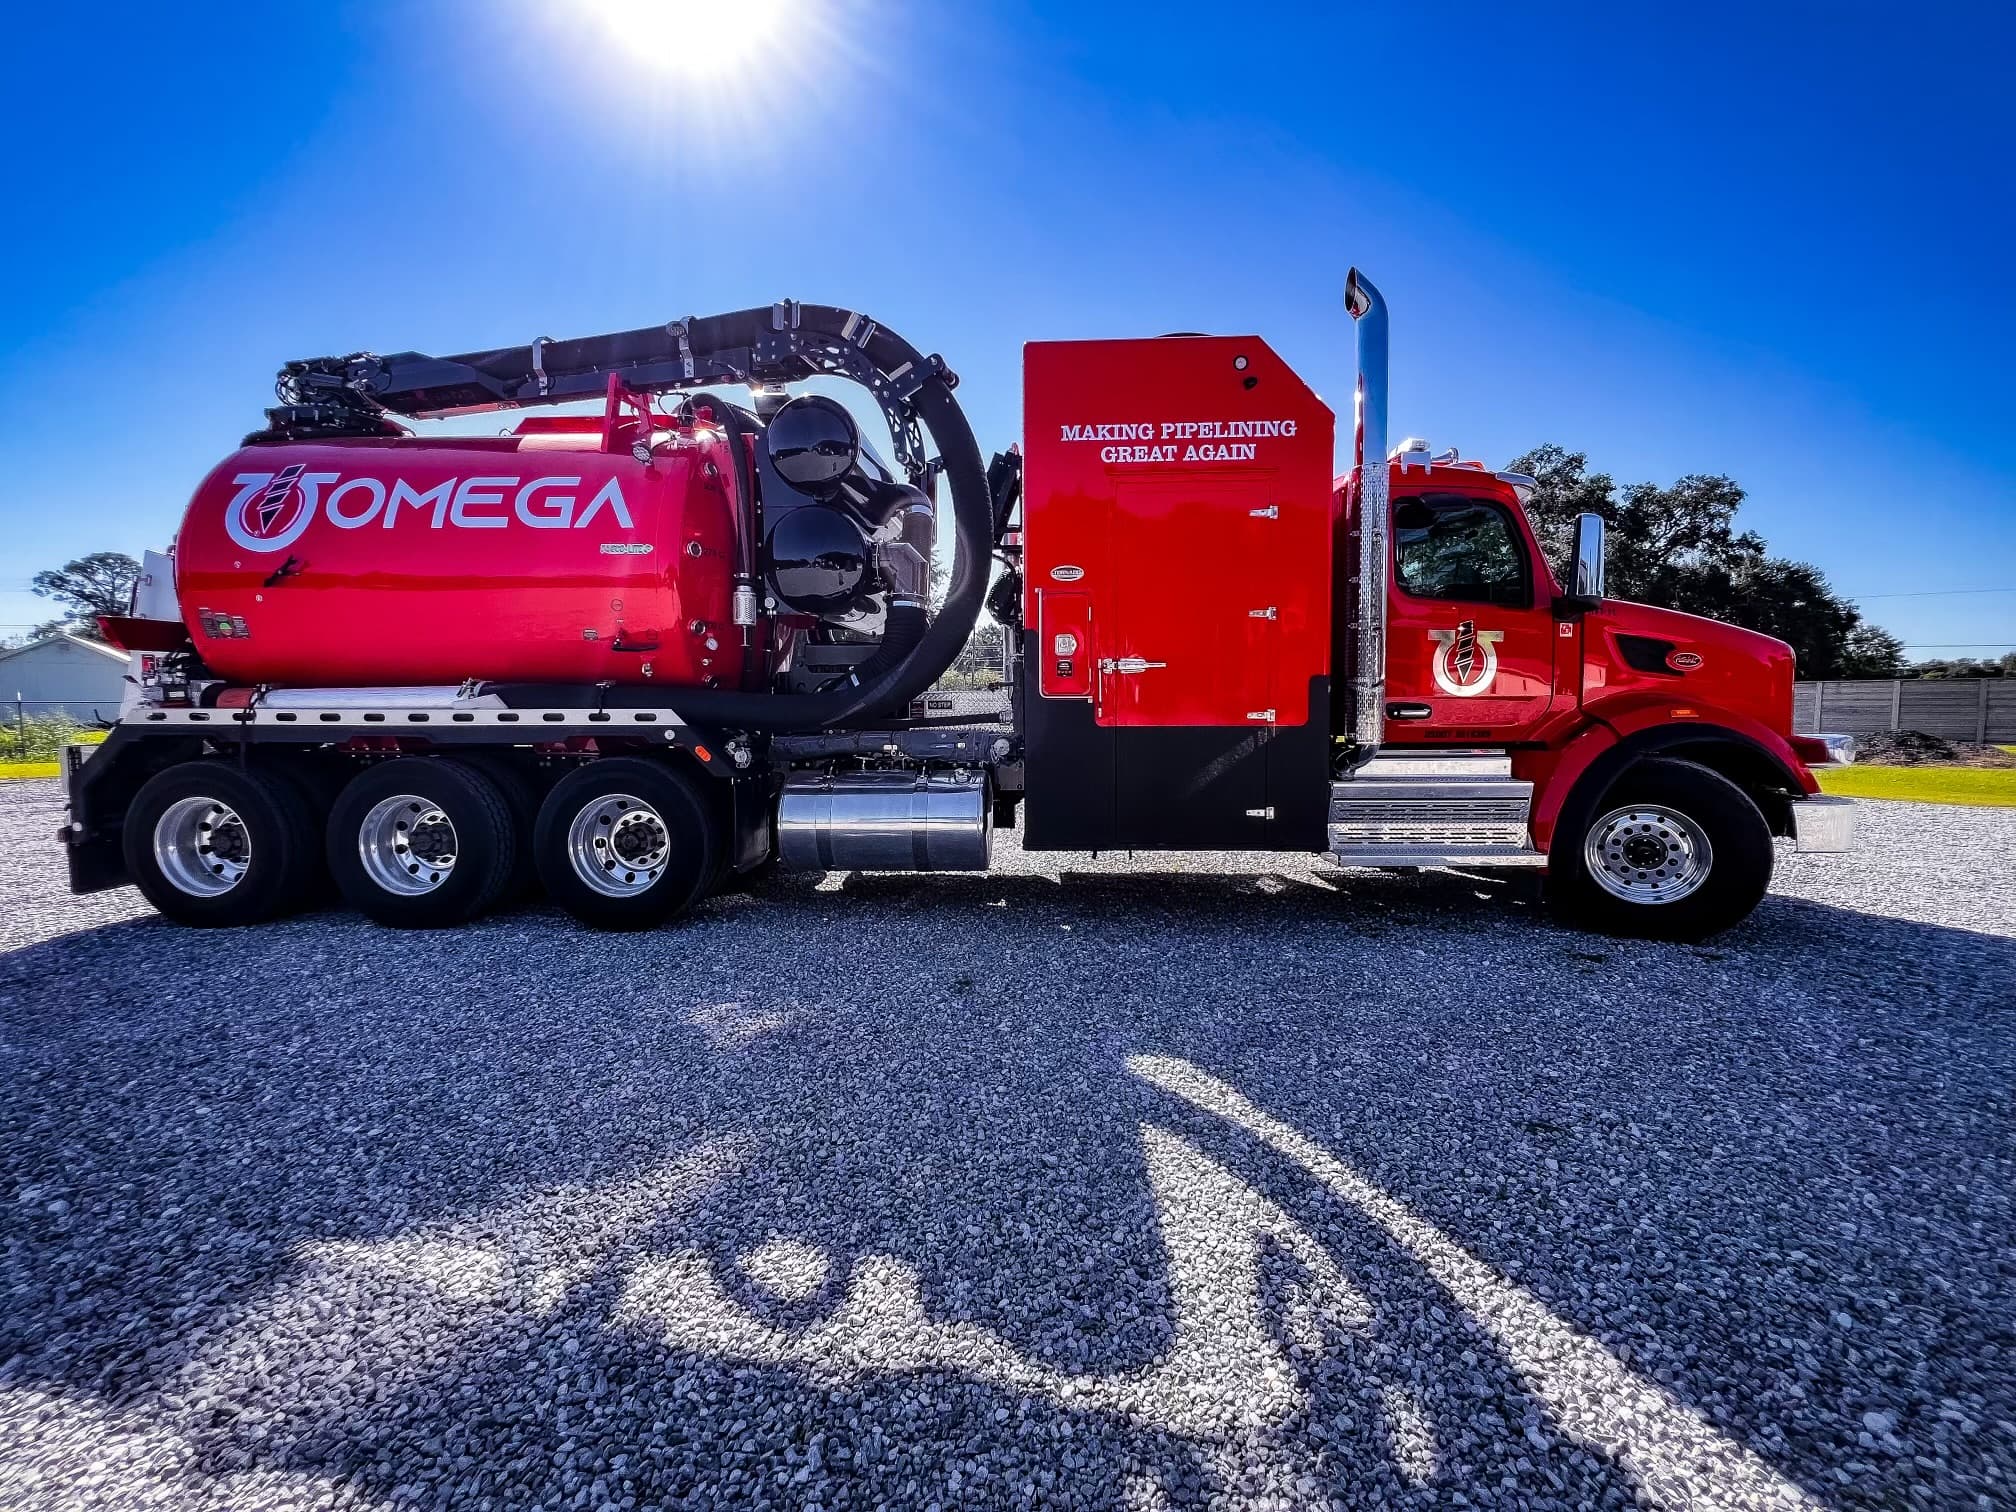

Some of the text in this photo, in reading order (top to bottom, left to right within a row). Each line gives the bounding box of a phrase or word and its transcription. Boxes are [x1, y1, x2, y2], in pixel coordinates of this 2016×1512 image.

[1060, 420, 1298, 442] MAKING PIPELINING
[1100, 443, 1257, 463] GREAT AGAIN
[325, 476, 634, 529] OMEGA
